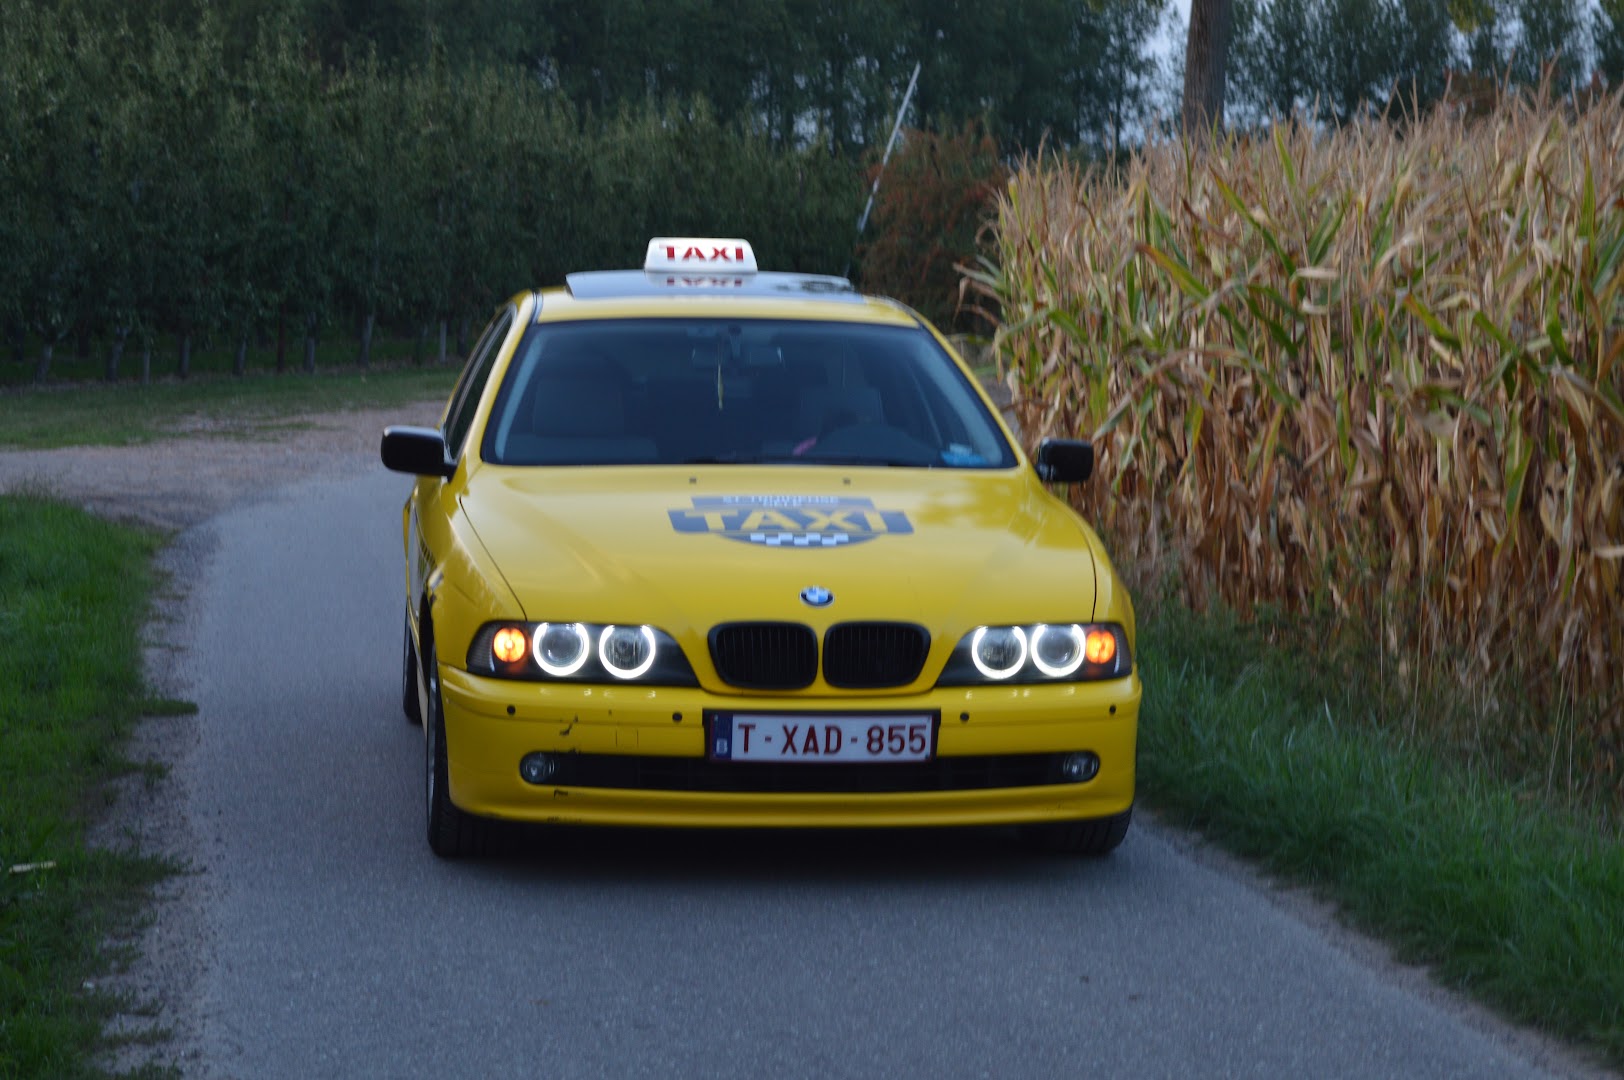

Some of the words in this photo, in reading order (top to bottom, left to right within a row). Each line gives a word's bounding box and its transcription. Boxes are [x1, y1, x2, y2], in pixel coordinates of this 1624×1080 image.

[660, 245, 744, 262] TAXI
[685, 510, 888, 532] TAXI
[738, 724, 927, 755] T-XAD-855
